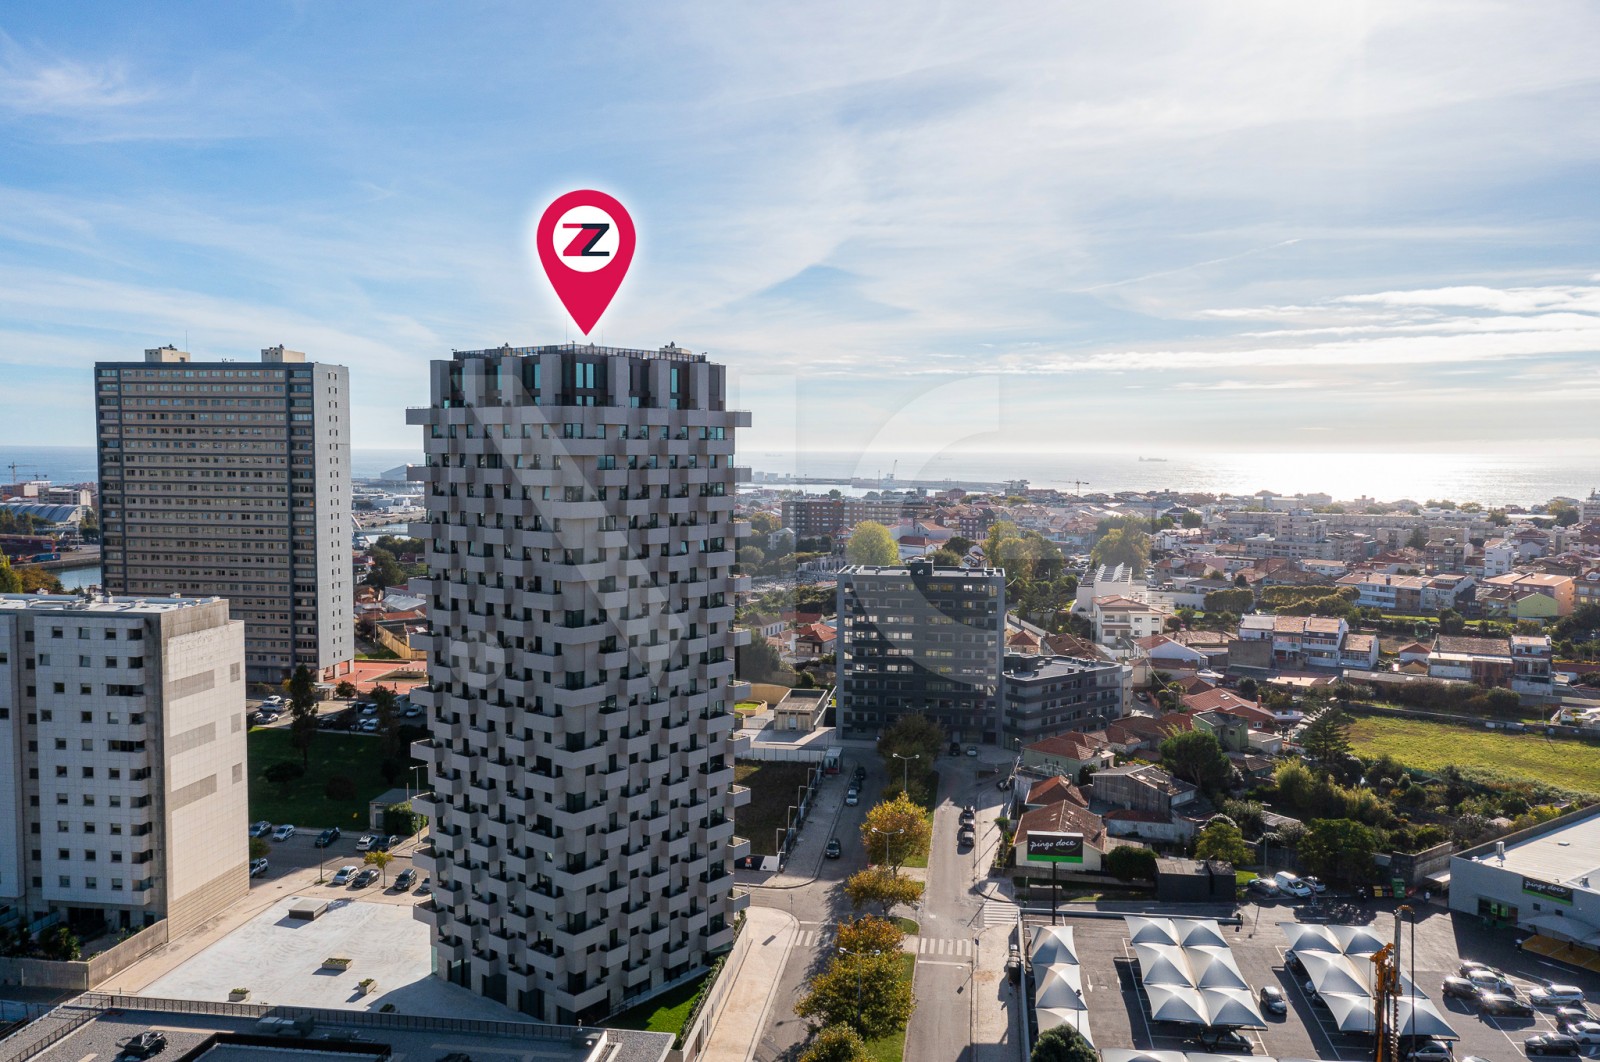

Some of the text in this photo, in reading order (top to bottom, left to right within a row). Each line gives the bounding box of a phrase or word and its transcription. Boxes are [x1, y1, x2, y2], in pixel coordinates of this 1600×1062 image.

[1030, 838, 1076, 851] pingo doce
[1525, 880, 1566, 893] pingo doce
